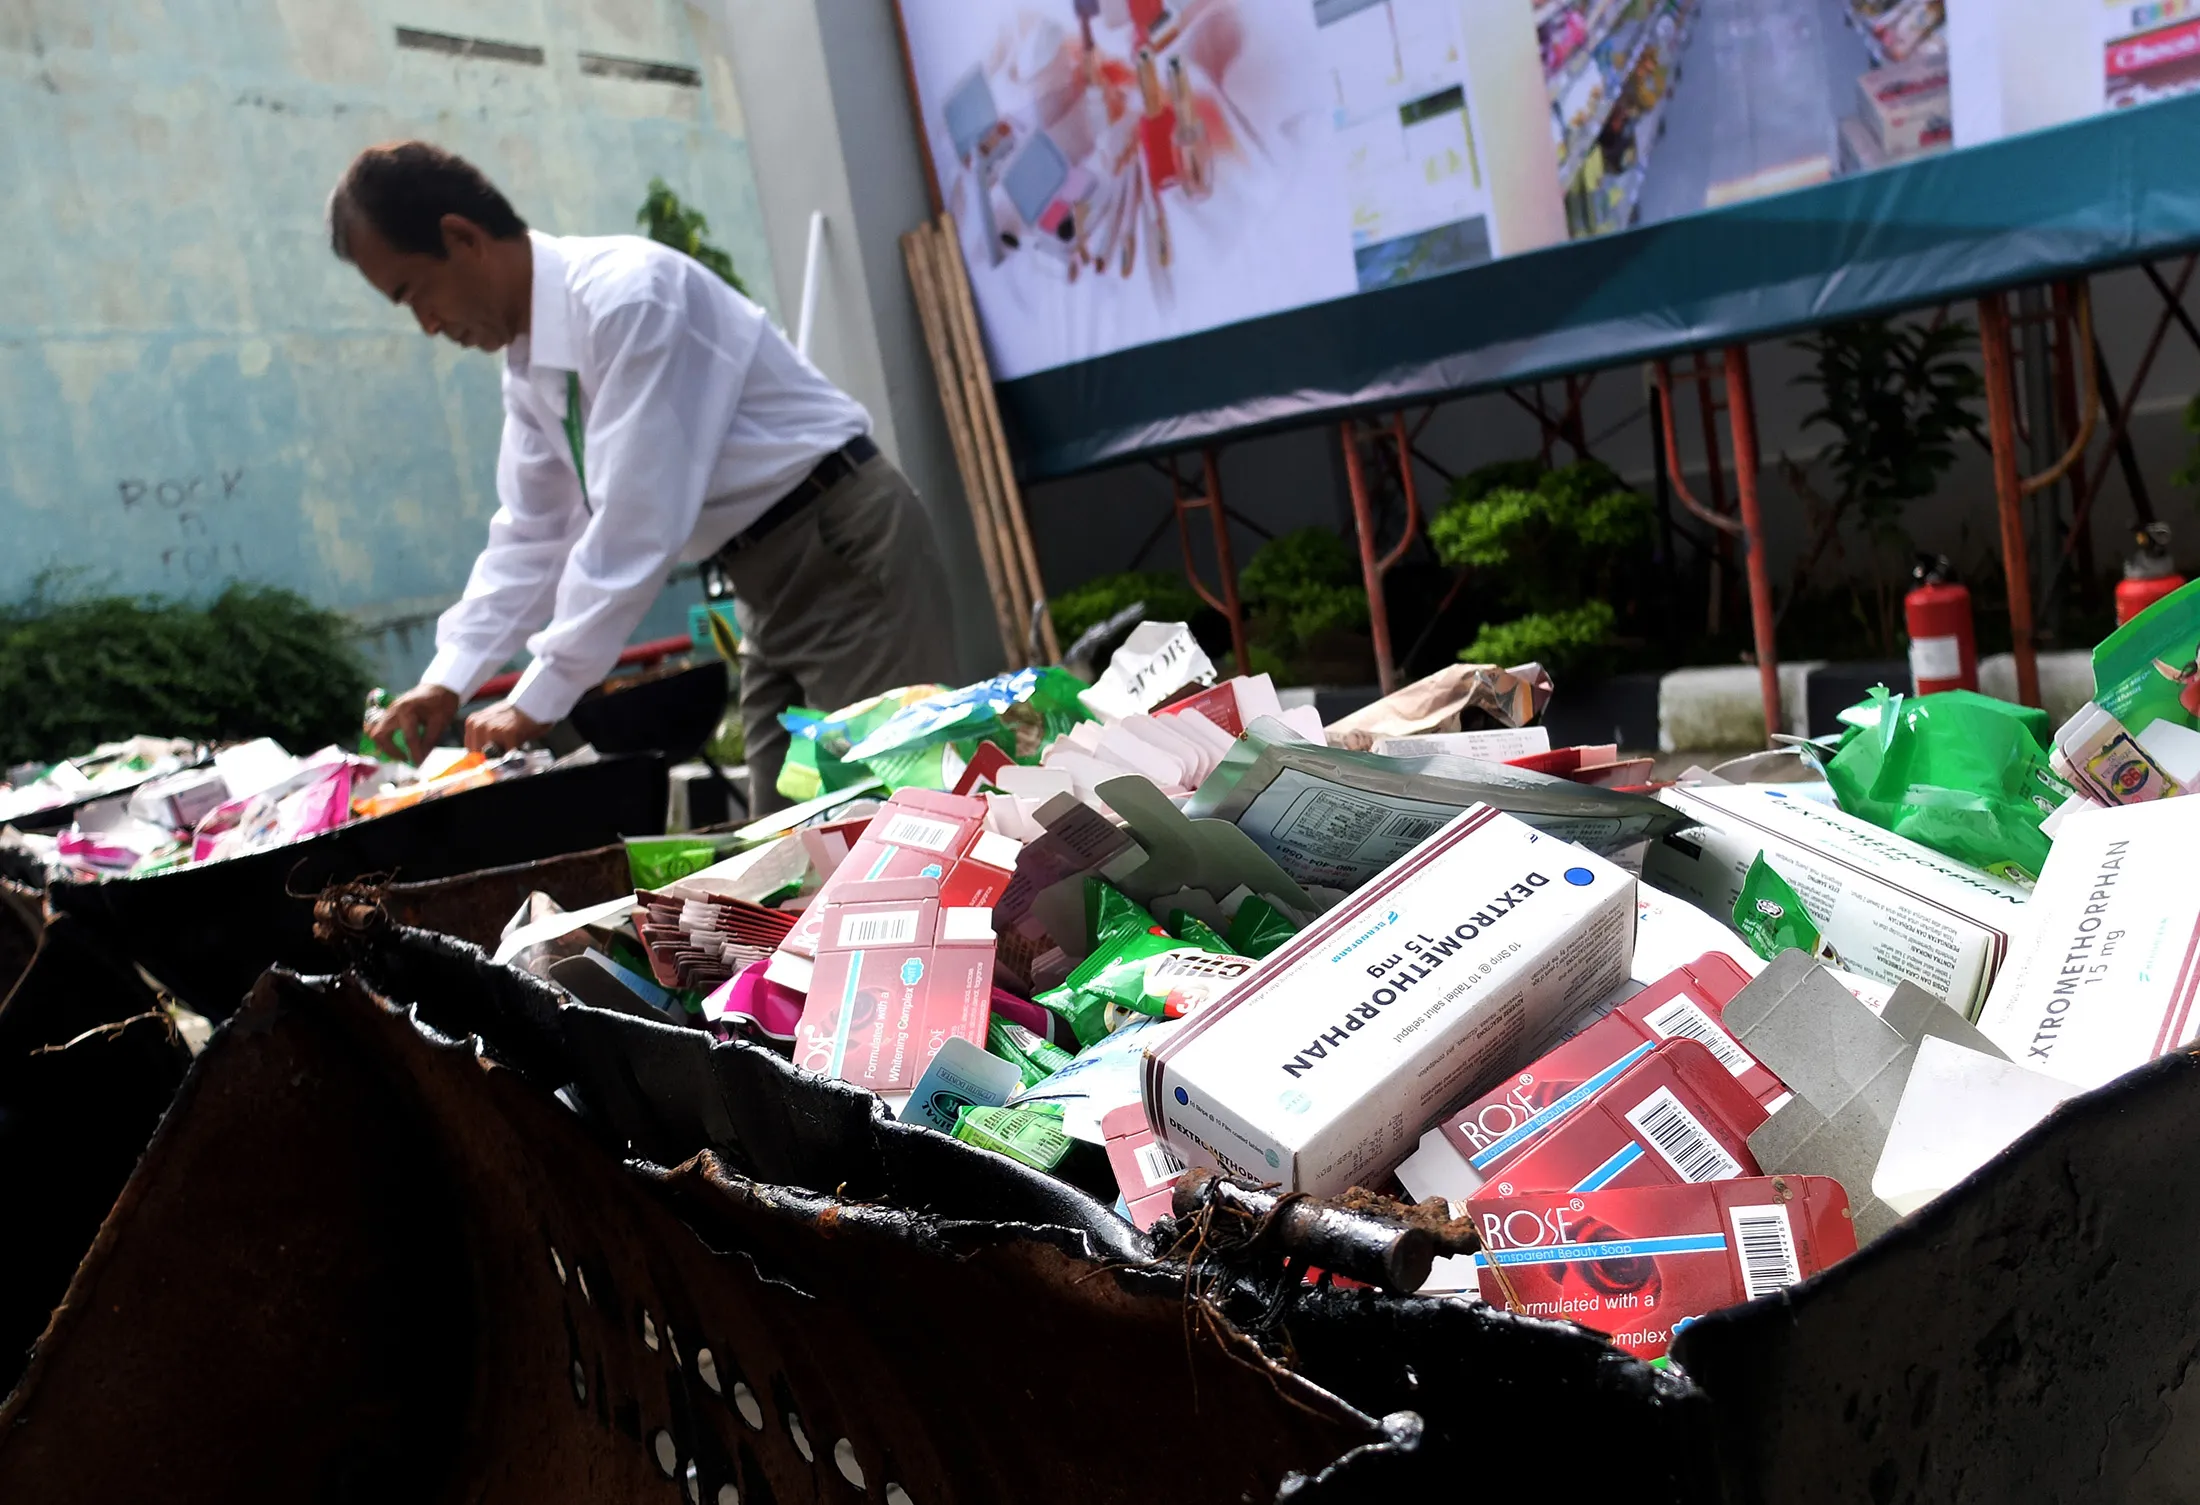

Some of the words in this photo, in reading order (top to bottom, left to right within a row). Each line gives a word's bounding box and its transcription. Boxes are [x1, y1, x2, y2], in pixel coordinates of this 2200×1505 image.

[1827, 884, 1839, 893] EFEK
[1887, 915, 1916, 932] PERHATIAN
[1914, 928, 1927, 937] DAN
[1328, 917, 1387, 966] BERNOFARM
[1401, 926, 1435, 958] 15
[1506, 938, 1522, 954] 10
[1926, 933, 1960, 953] PERINGATAN
[2027, 839, 2131, 1063] XTROMETHORPHAN
[1487, 947, 1511, 969] Strip
[1909, 944, 1933, 959] INDIKASI
[2084, 959, 2109, 989] 15
[2097, 924, 2126, 961] mg
[1154, 951, 1251, 980] MILO
[1364, 950, 1405, 984] mg
[1476, 960, 1493, 976] @
[1875, 954, 1905, 972] PEMBERIAN
[1932, 954, 1955, 969] KONTRA
[1279, 865, 1550, 1083] DEXTROMETHORPHAN
[1467, 970, 1483, 986] 10
[1904, 968, 1920, 979] CARA
[1919, 975, 1932, 984] DAN
[1442, 978, 1472, 1005] Tablet
[1931, 980, 1949, 993] DOSIS
[1422, 998, 1447, 1022] salut
[864, 1021, 885, 1079] Formulated
[876, 1000, 887, 1021] with
[888, 1031, 908, 1082] Whitening
[898, 986, 915, 1030] Complex
[1390, 1014, 1427, 1046] selaput
[1481, 1120, 1538, 1161] Transparent
[1534, 1100, 1568, 1126] Beauty
[1565, 1084, 1591, 1105] Soap
[1497, 1248, 1554, 1263] ansparent
[1557, 1245, 1597, 1258] Beauty
[1600, 1244, 1631, 1255] Soap
[1609, 1294, 1637, 1307] with
[1643, 1295, 1654, 1306] a
[1609, 1327, 1667, 1345] omplex
